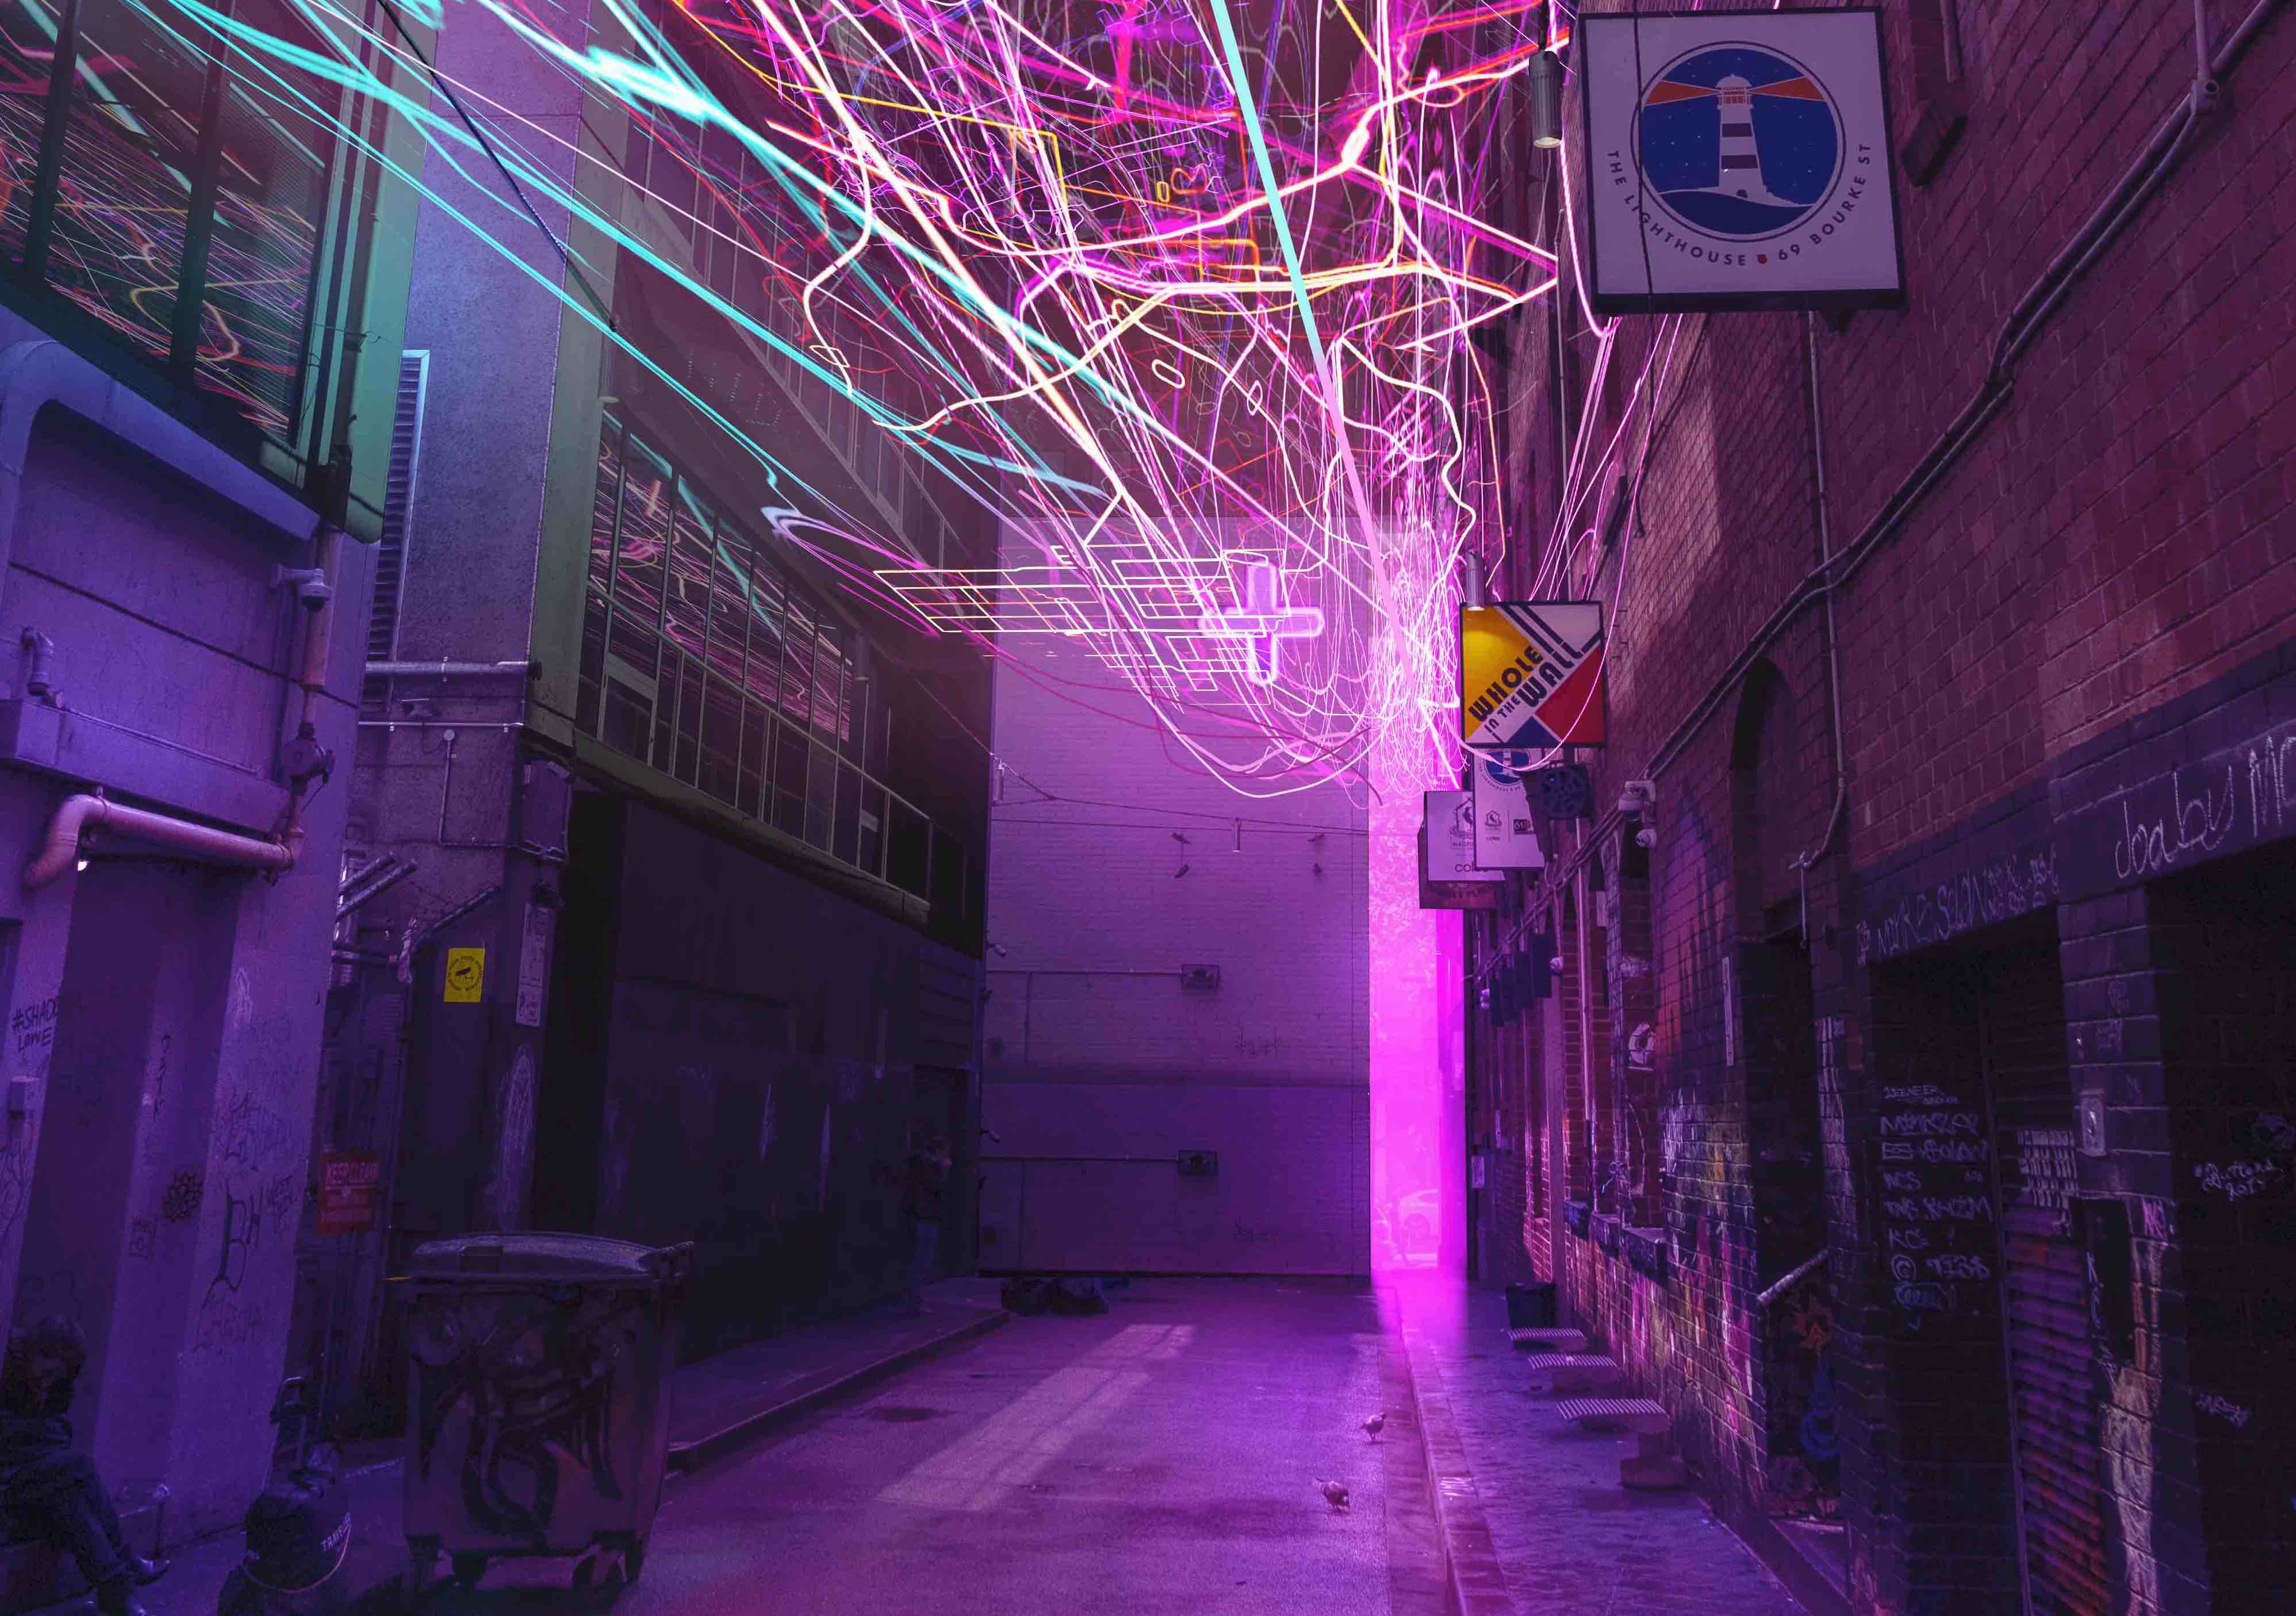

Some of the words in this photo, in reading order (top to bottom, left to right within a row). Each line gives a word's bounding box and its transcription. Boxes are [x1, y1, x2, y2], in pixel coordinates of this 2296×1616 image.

[1607, 150, 1627, 186] THE
[1624, 194, 1746, 266] LIGHTHOUSE
[1778, 243, 1800, 261] 69
[1809, 175, 1866, 245] BOURKE
[1858, 144, 1871, 165] ST
[1468, 645, 1544, 722] WHOLE
[1497, 694, 1521, 718] THE
[1516, 641, 1584, 708] WALL
